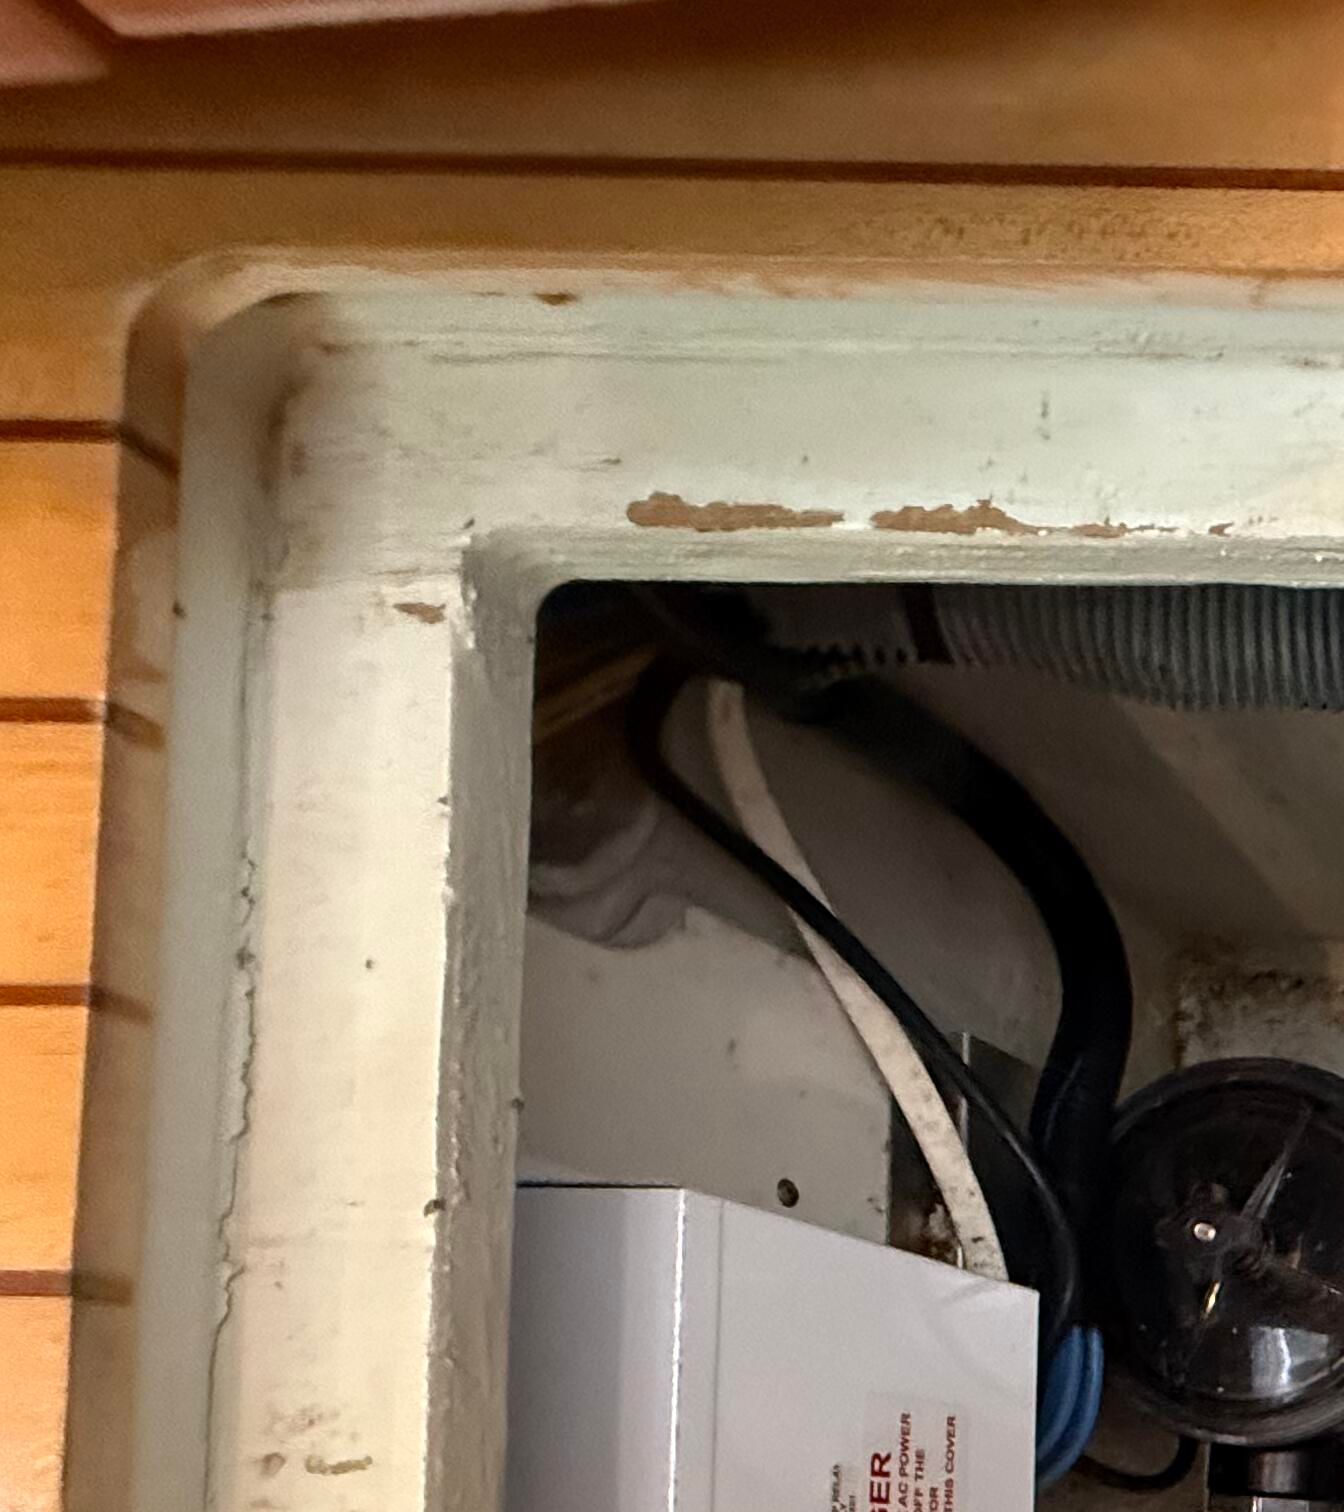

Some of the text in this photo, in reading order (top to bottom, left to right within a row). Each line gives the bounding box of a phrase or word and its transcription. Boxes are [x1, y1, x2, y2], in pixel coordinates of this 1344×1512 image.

[898, 1412, 911, 1478] POWER
[914, 1448, 925, 1482] THE
[944, 1414, 956, 1474] COVER
[897, 1482, 909, 1507] AC
